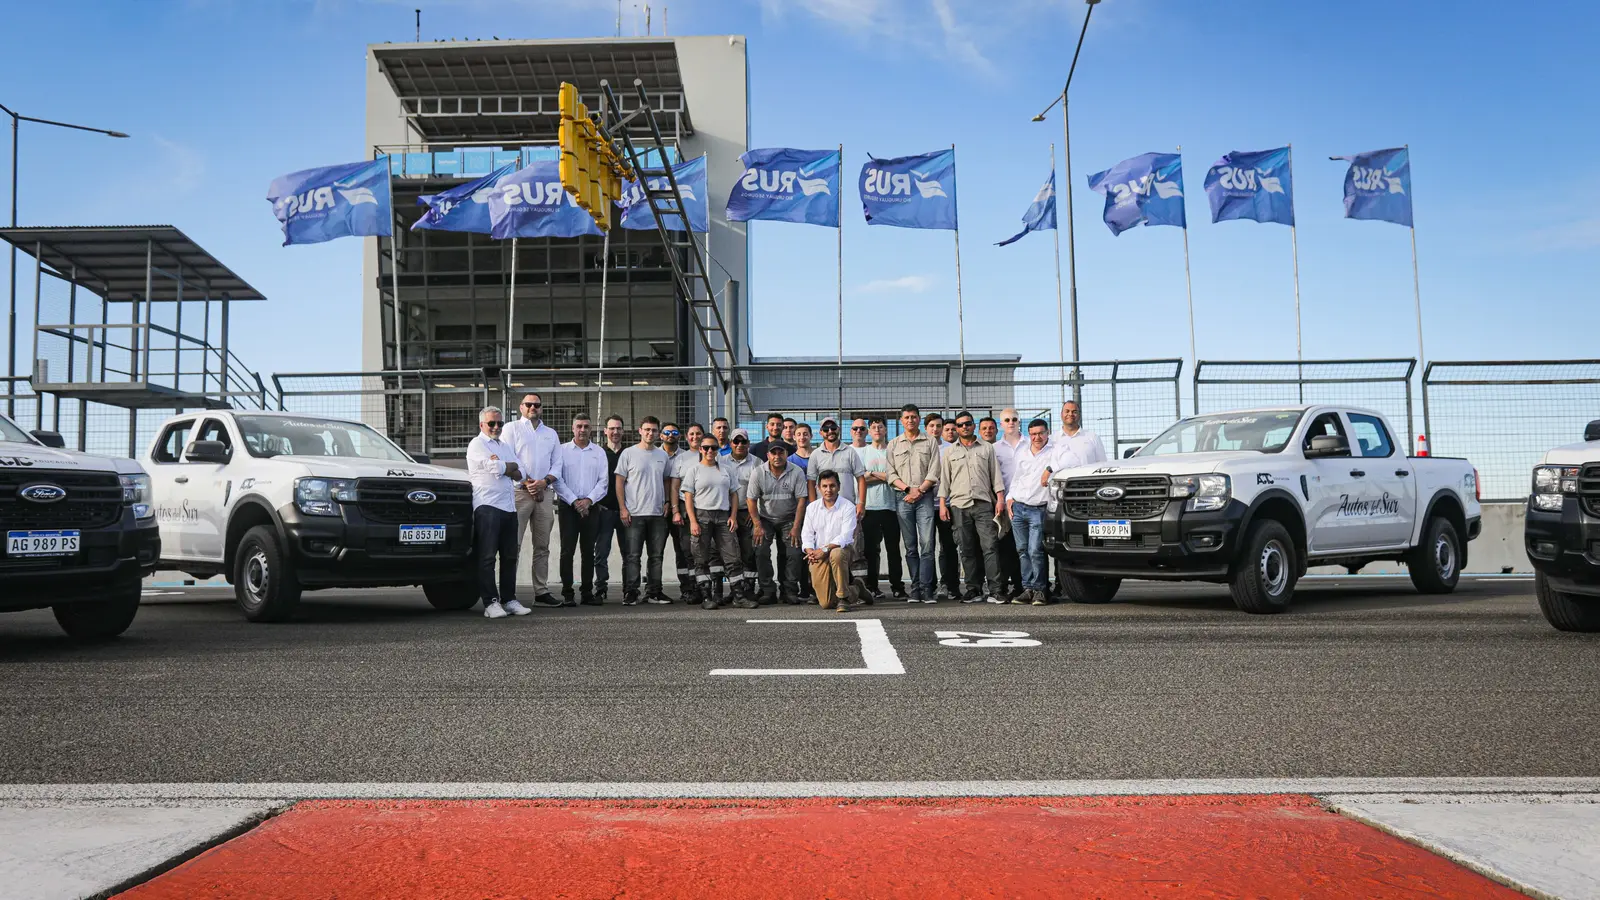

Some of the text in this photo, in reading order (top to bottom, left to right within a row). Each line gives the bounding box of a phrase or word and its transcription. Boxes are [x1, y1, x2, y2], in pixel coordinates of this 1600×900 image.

[153, 502, 172, 519] utos
[182, 498, 198, 520] Sur
[1336, 493, 1369, 517] Autos
[1380, 491, 1399, 515] Sur
[402, 530, 444, 540] AG 853 PU
[1090, 525, 1129, 535] AG 989 PN
[11, 537, 77, 551] AG 989 PS
